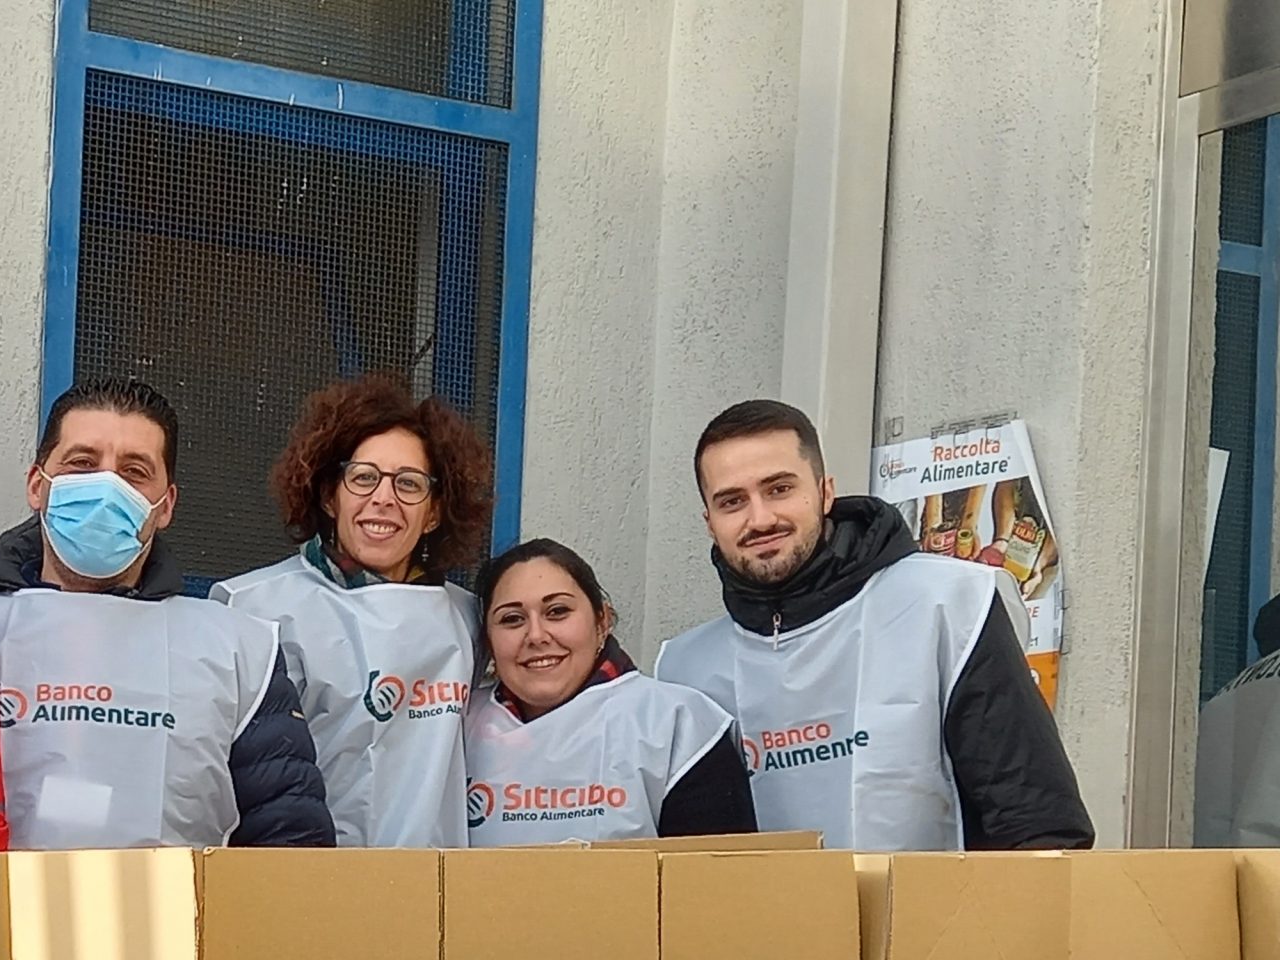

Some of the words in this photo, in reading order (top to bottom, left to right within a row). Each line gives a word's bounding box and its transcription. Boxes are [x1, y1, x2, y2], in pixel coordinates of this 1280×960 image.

[933, 438, 1000, 462] Raccolta
[920, 457, 1009, 483] Alimentare
[37, 684, 112, 702] Banco
[32, 704, 176, 729] Alimentare
[408, 707, 443, 719] Banco
[762, 723, 831, 750] Banco
[503, 783, 627, 811] Siticibo
[502, 811, 538, 822] Banco
[540, 807, 605, 821] Alimentare
